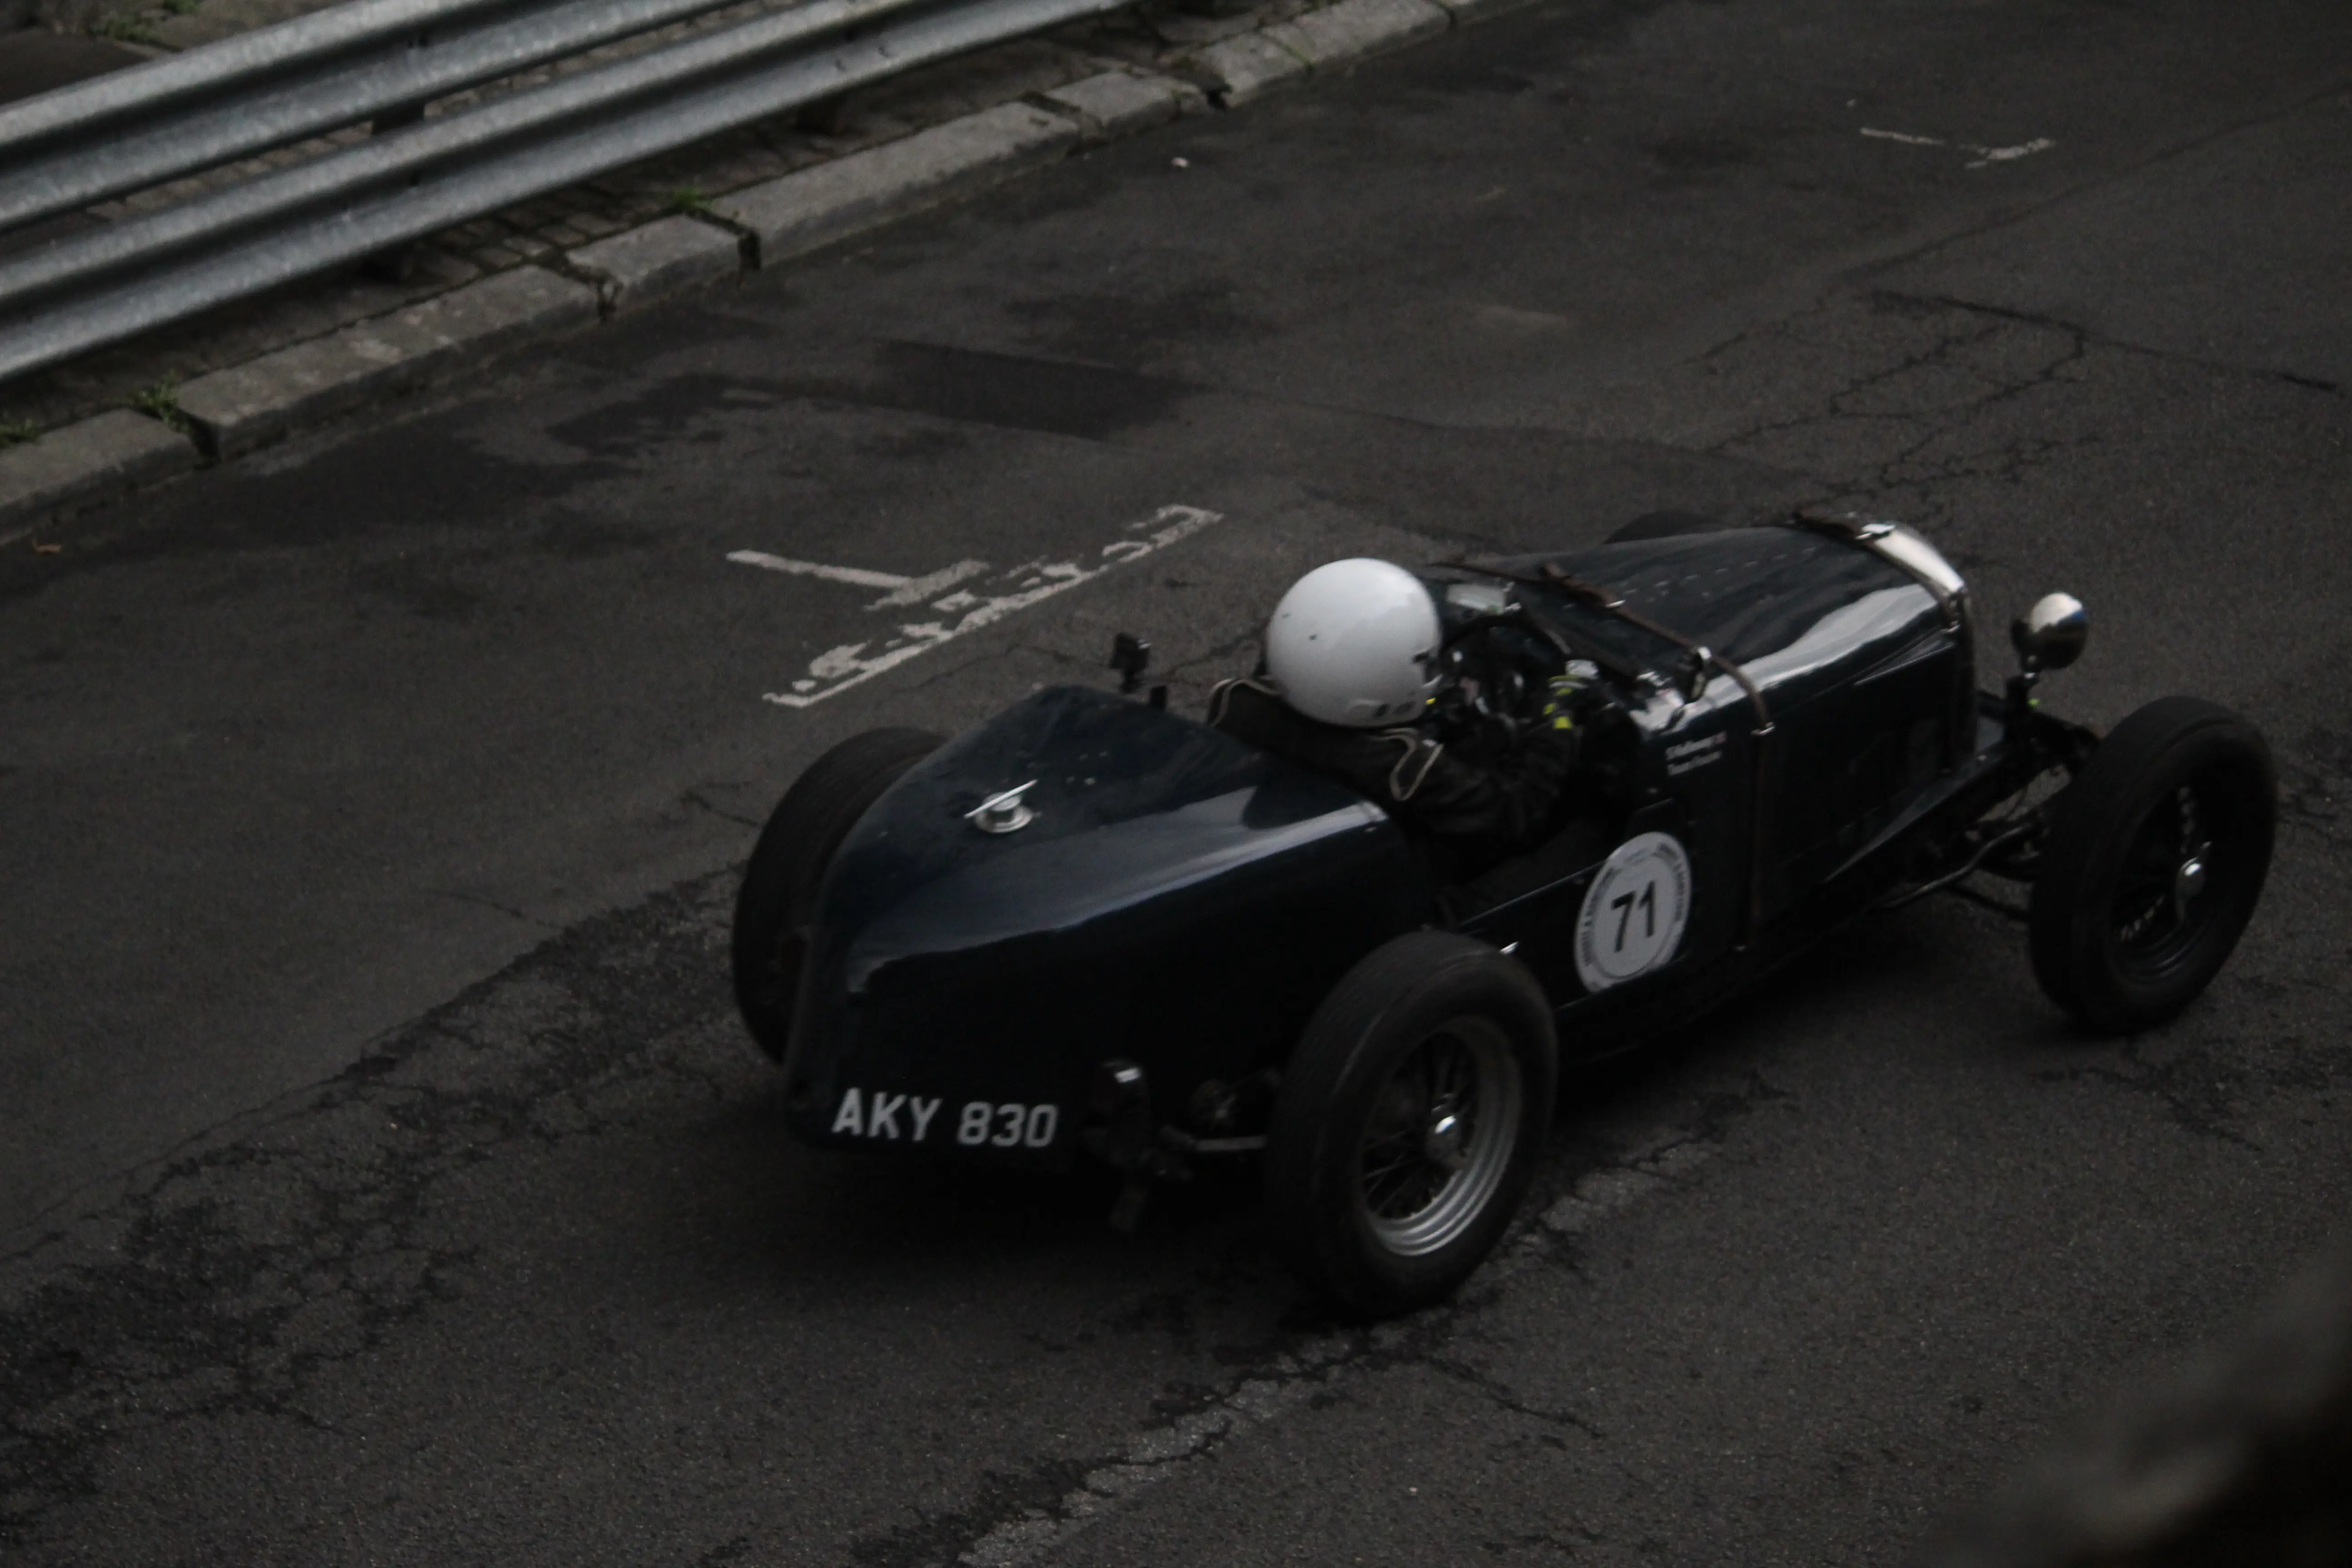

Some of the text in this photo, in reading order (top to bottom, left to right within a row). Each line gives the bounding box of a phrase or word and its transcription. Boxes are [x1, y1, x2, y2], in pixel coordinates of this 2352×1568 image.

[1611, 880, 1655, 953] 71
[832, 1087, 1059, 1148] AKY 830
